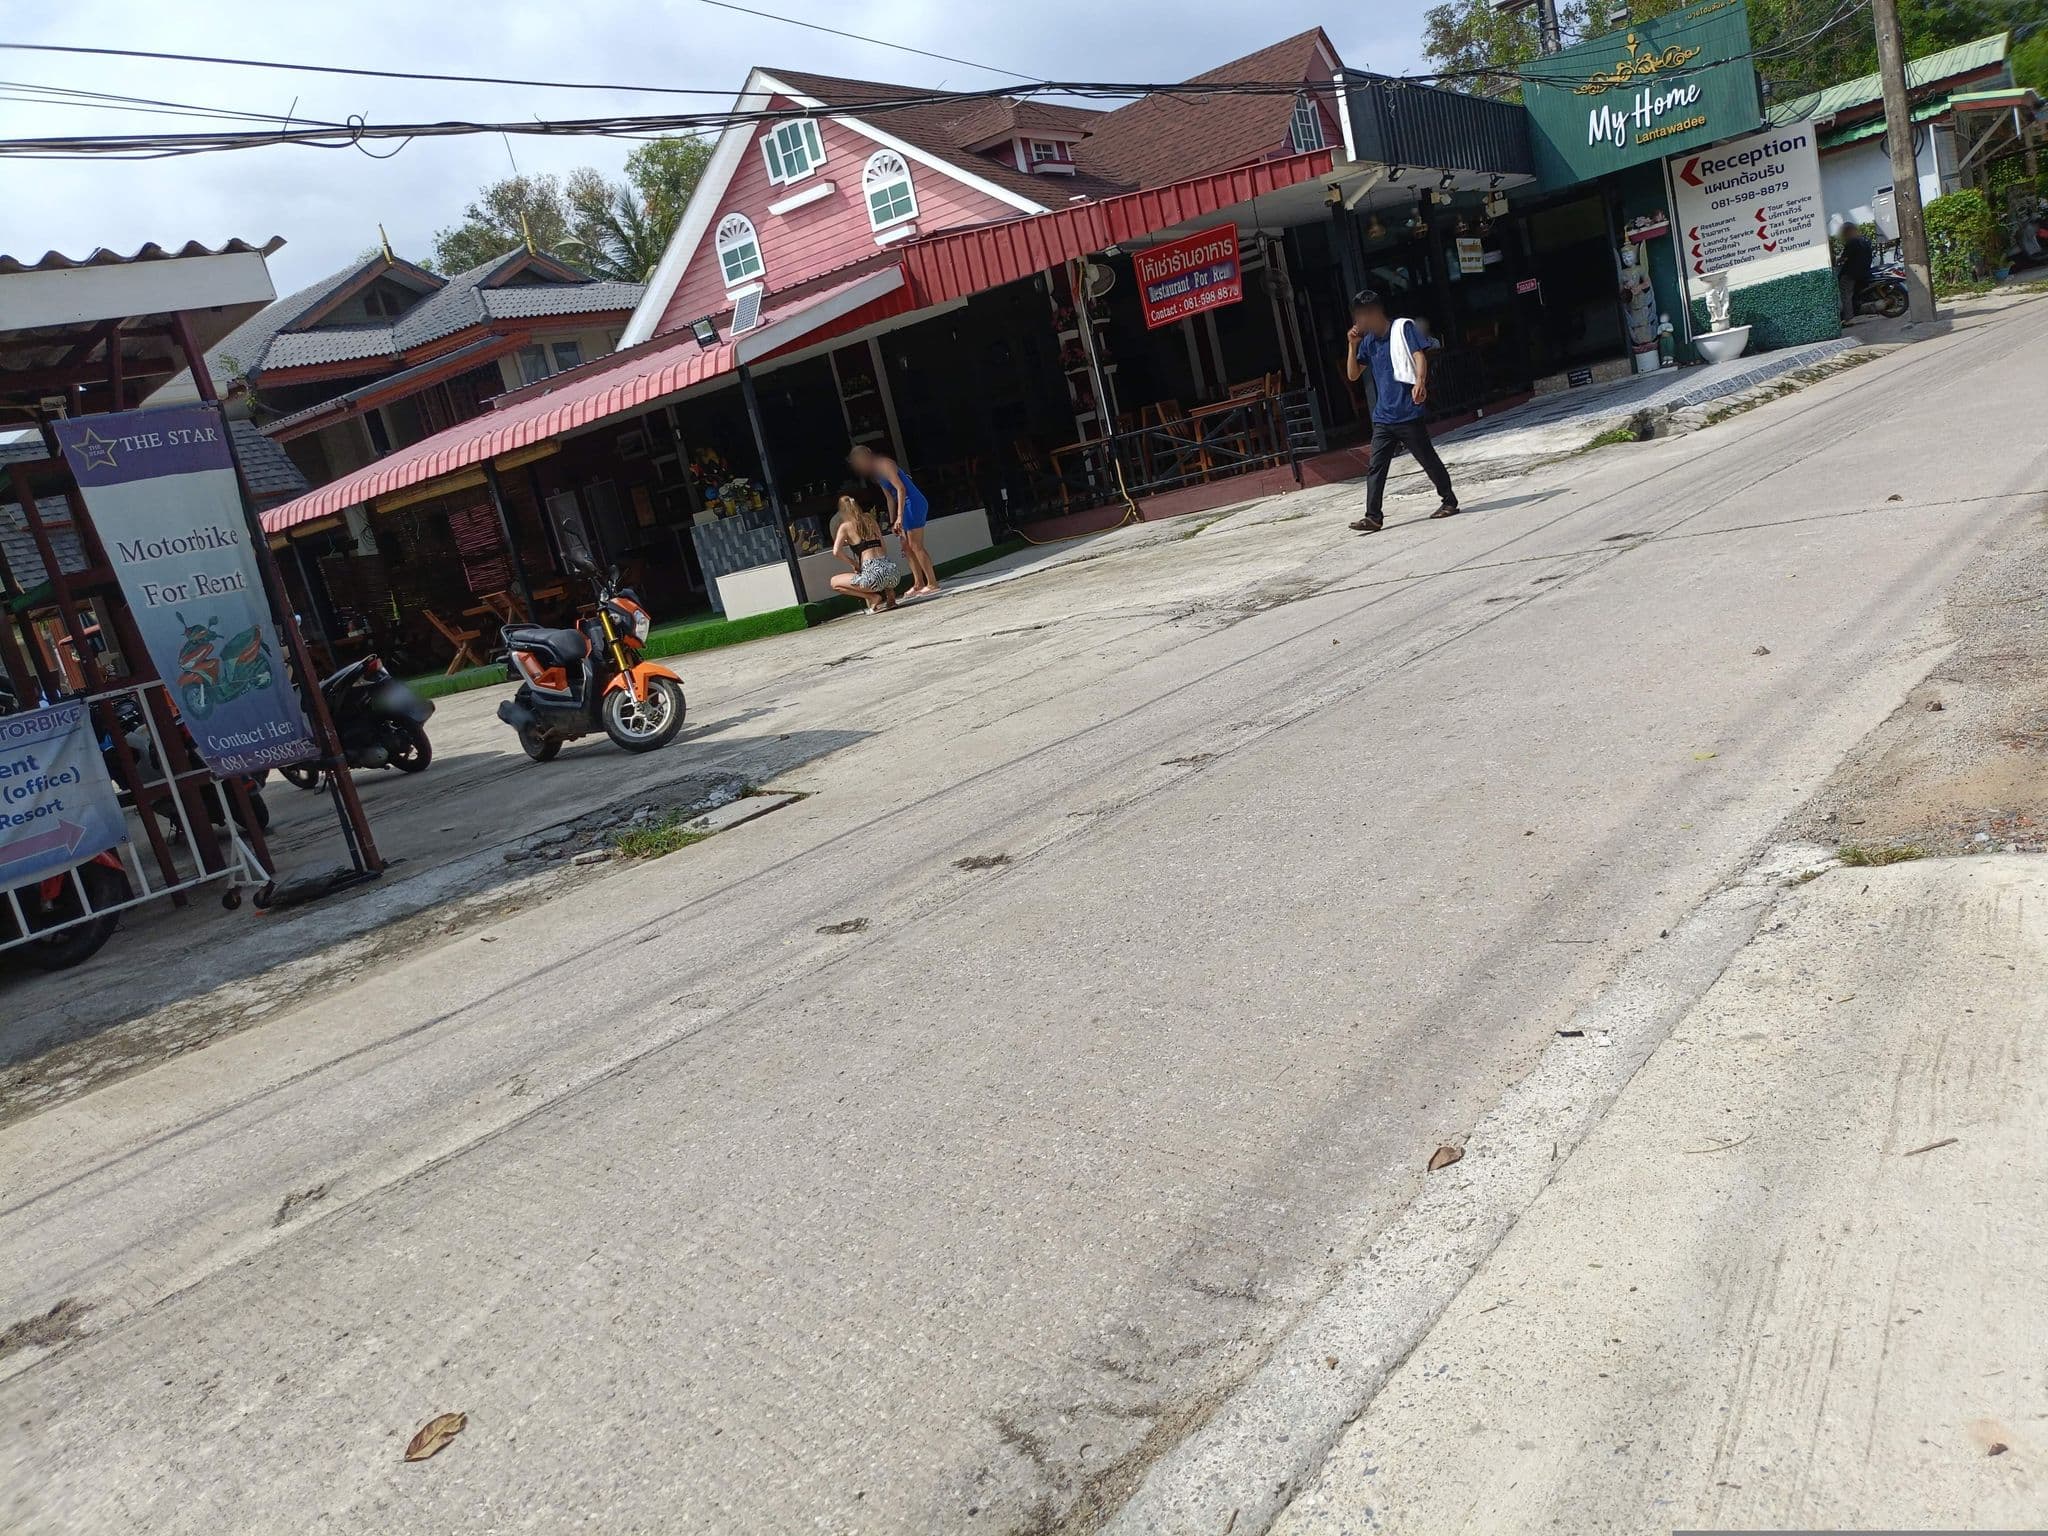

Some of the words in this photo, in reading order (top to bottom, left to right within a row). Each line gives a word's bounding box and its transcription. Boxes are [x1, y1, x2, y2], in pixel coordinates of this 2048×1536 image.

[1588, 105, 1629, 147] My
[1631, 84, 1700, 129] Home
[1635, 115, 1706, 144] Lantawadee
[1701, 135, 1806, 177] Reception
[1704, 164, 1785, 195] แผนกต้อนรับ
[1711, 181, 1789, 210] 081-598-8879
[1767, 203, 1783, 211] Tour
[1786, 195, 1812, 206] Service
[1729, 229, 1754, 240] Service
[1769, 220, 1785, 229] Taxi
[1788, 213, 1815, 224] Service
[1778, 236, 1795, 245] Cafe
[1148, 276, 1190, 303] Restaurant
[1193, 271, 1208, 288] For
[1150, 304, 1177, 321] Contact
[120, 433, 163, 452] THE
[168, 427, 218, 446] STAR
[116, 526, 240, 563] Motorbike
[141, 583, 188, 606] For
[192, 570, 245, 597] Rent
[207, 728, 264, 751] Contact
[3, 766, 80, 804] (office)
[0, 799, 64, 830] Resort
